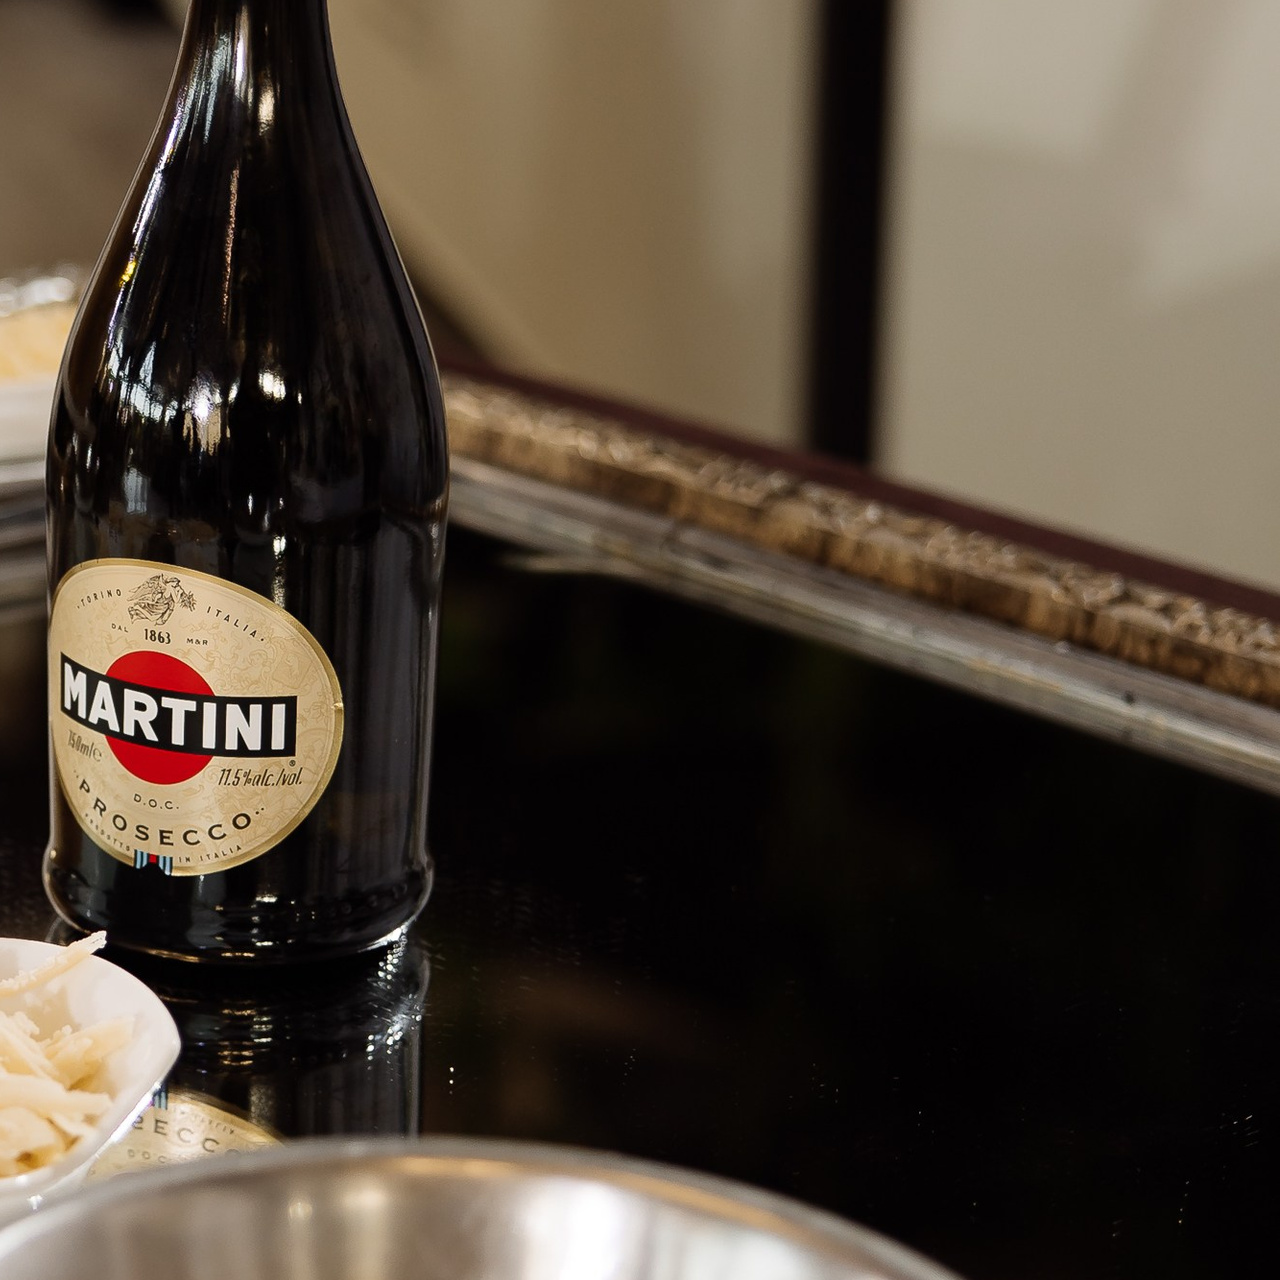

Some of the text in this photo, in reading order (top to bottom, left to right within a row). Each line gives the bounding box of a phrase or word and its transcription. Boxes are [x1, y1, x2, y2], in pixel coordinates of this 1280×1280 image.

[80, 589, 257, 638] TORINO ITALIA
[111, 623, 209, 646] DAL 1863 M&R
[64, 662, 286, 751] MARTINI
[79, 779, 252, 846] PROSECCO
[134, 793, 180, 810] D.O.C.
[178, 855, 190, 864] IN
[200, 845, 243, 862] ITALIA
